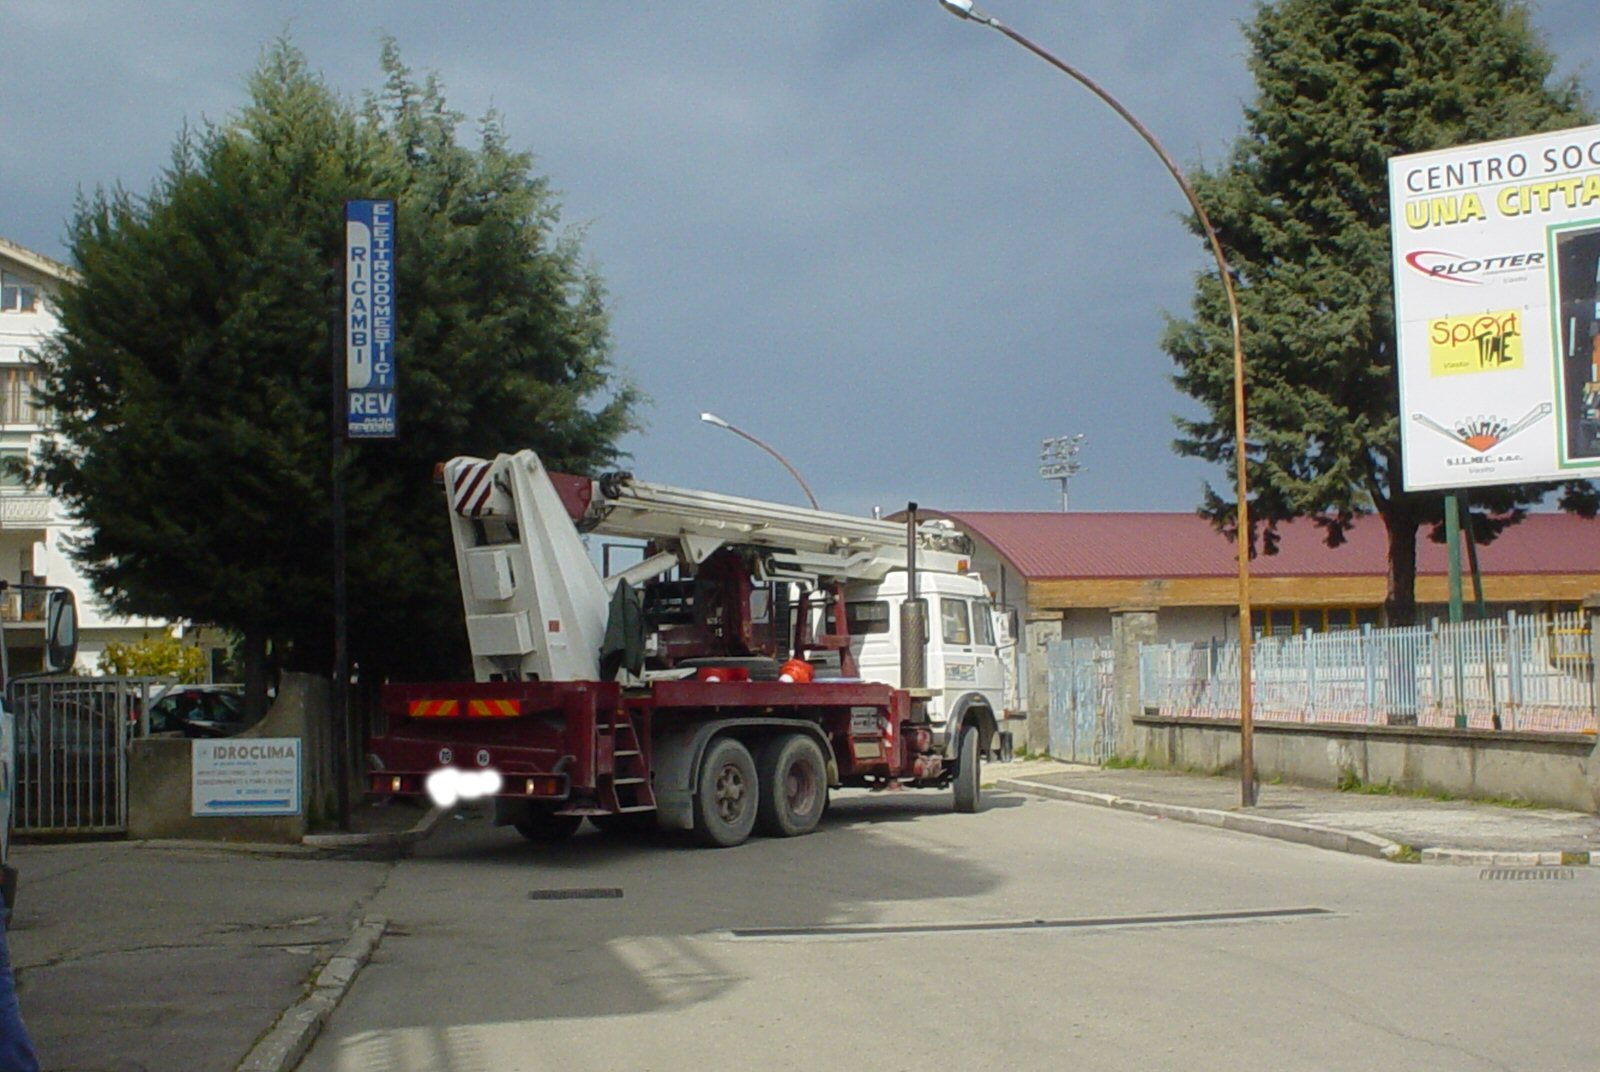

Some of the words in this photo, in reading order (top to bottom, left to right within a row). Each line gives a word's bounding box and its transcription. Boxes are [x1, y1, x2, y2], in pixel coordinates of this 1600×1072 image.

[1406, 153, 1527, 192] CENTRO
[1405, 191, 1487, 231] UNA
[1497, 174, 1600, 216] CITTA
[1430, 252, 1545, 277] PLOTTER
[350, 246, 368, 364] RICAMBI
[372, 202, 391, 386] ELETTRODOMESTICI
[1431, 312, 1521, 348] Sport
[1469, 331, 1514, 368] TIME
[350, 392, 393, 414] REV
[213, 745, 295, 759] IDROCLIMA
